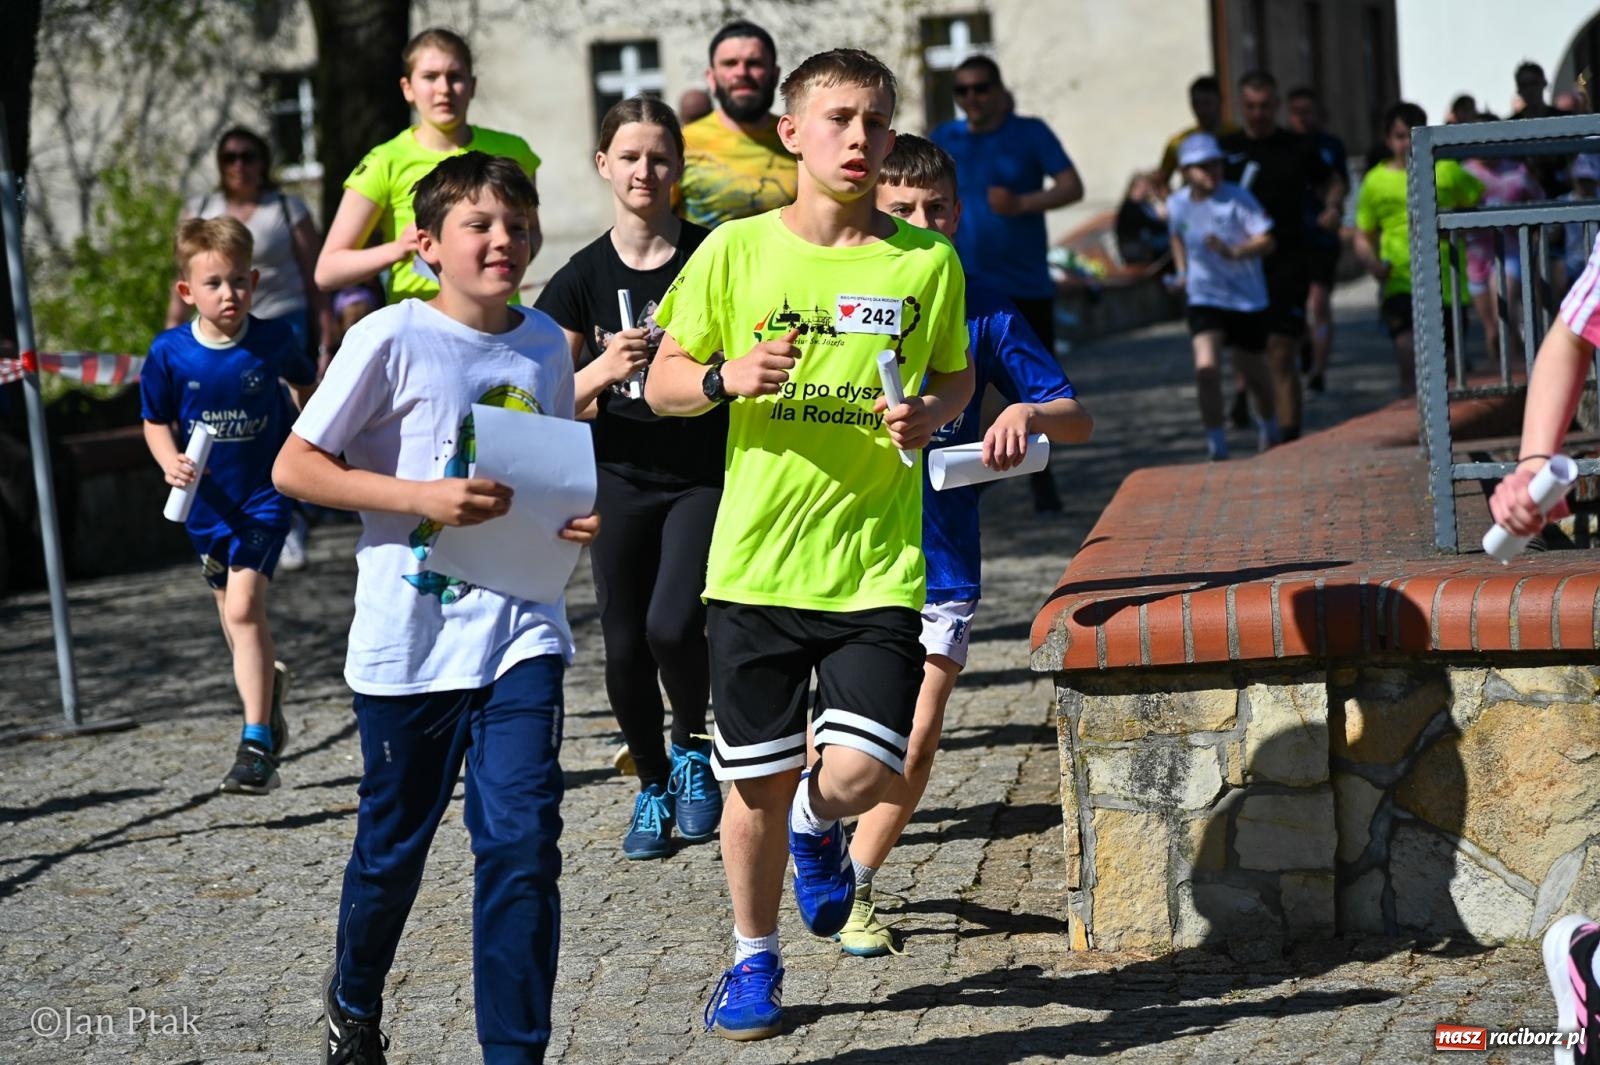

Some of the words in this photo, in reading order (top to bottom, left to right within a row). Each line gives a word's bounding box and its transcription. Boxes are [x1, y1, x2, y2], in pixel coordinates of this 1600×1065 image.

[862, 307, 895, 326] 242
[803, 382, 830, 400] po
[836, 381, 884, 403] dysz
[201, 408, 248, 421] GMINA
[802, 404, 885, 430] Rodziny
